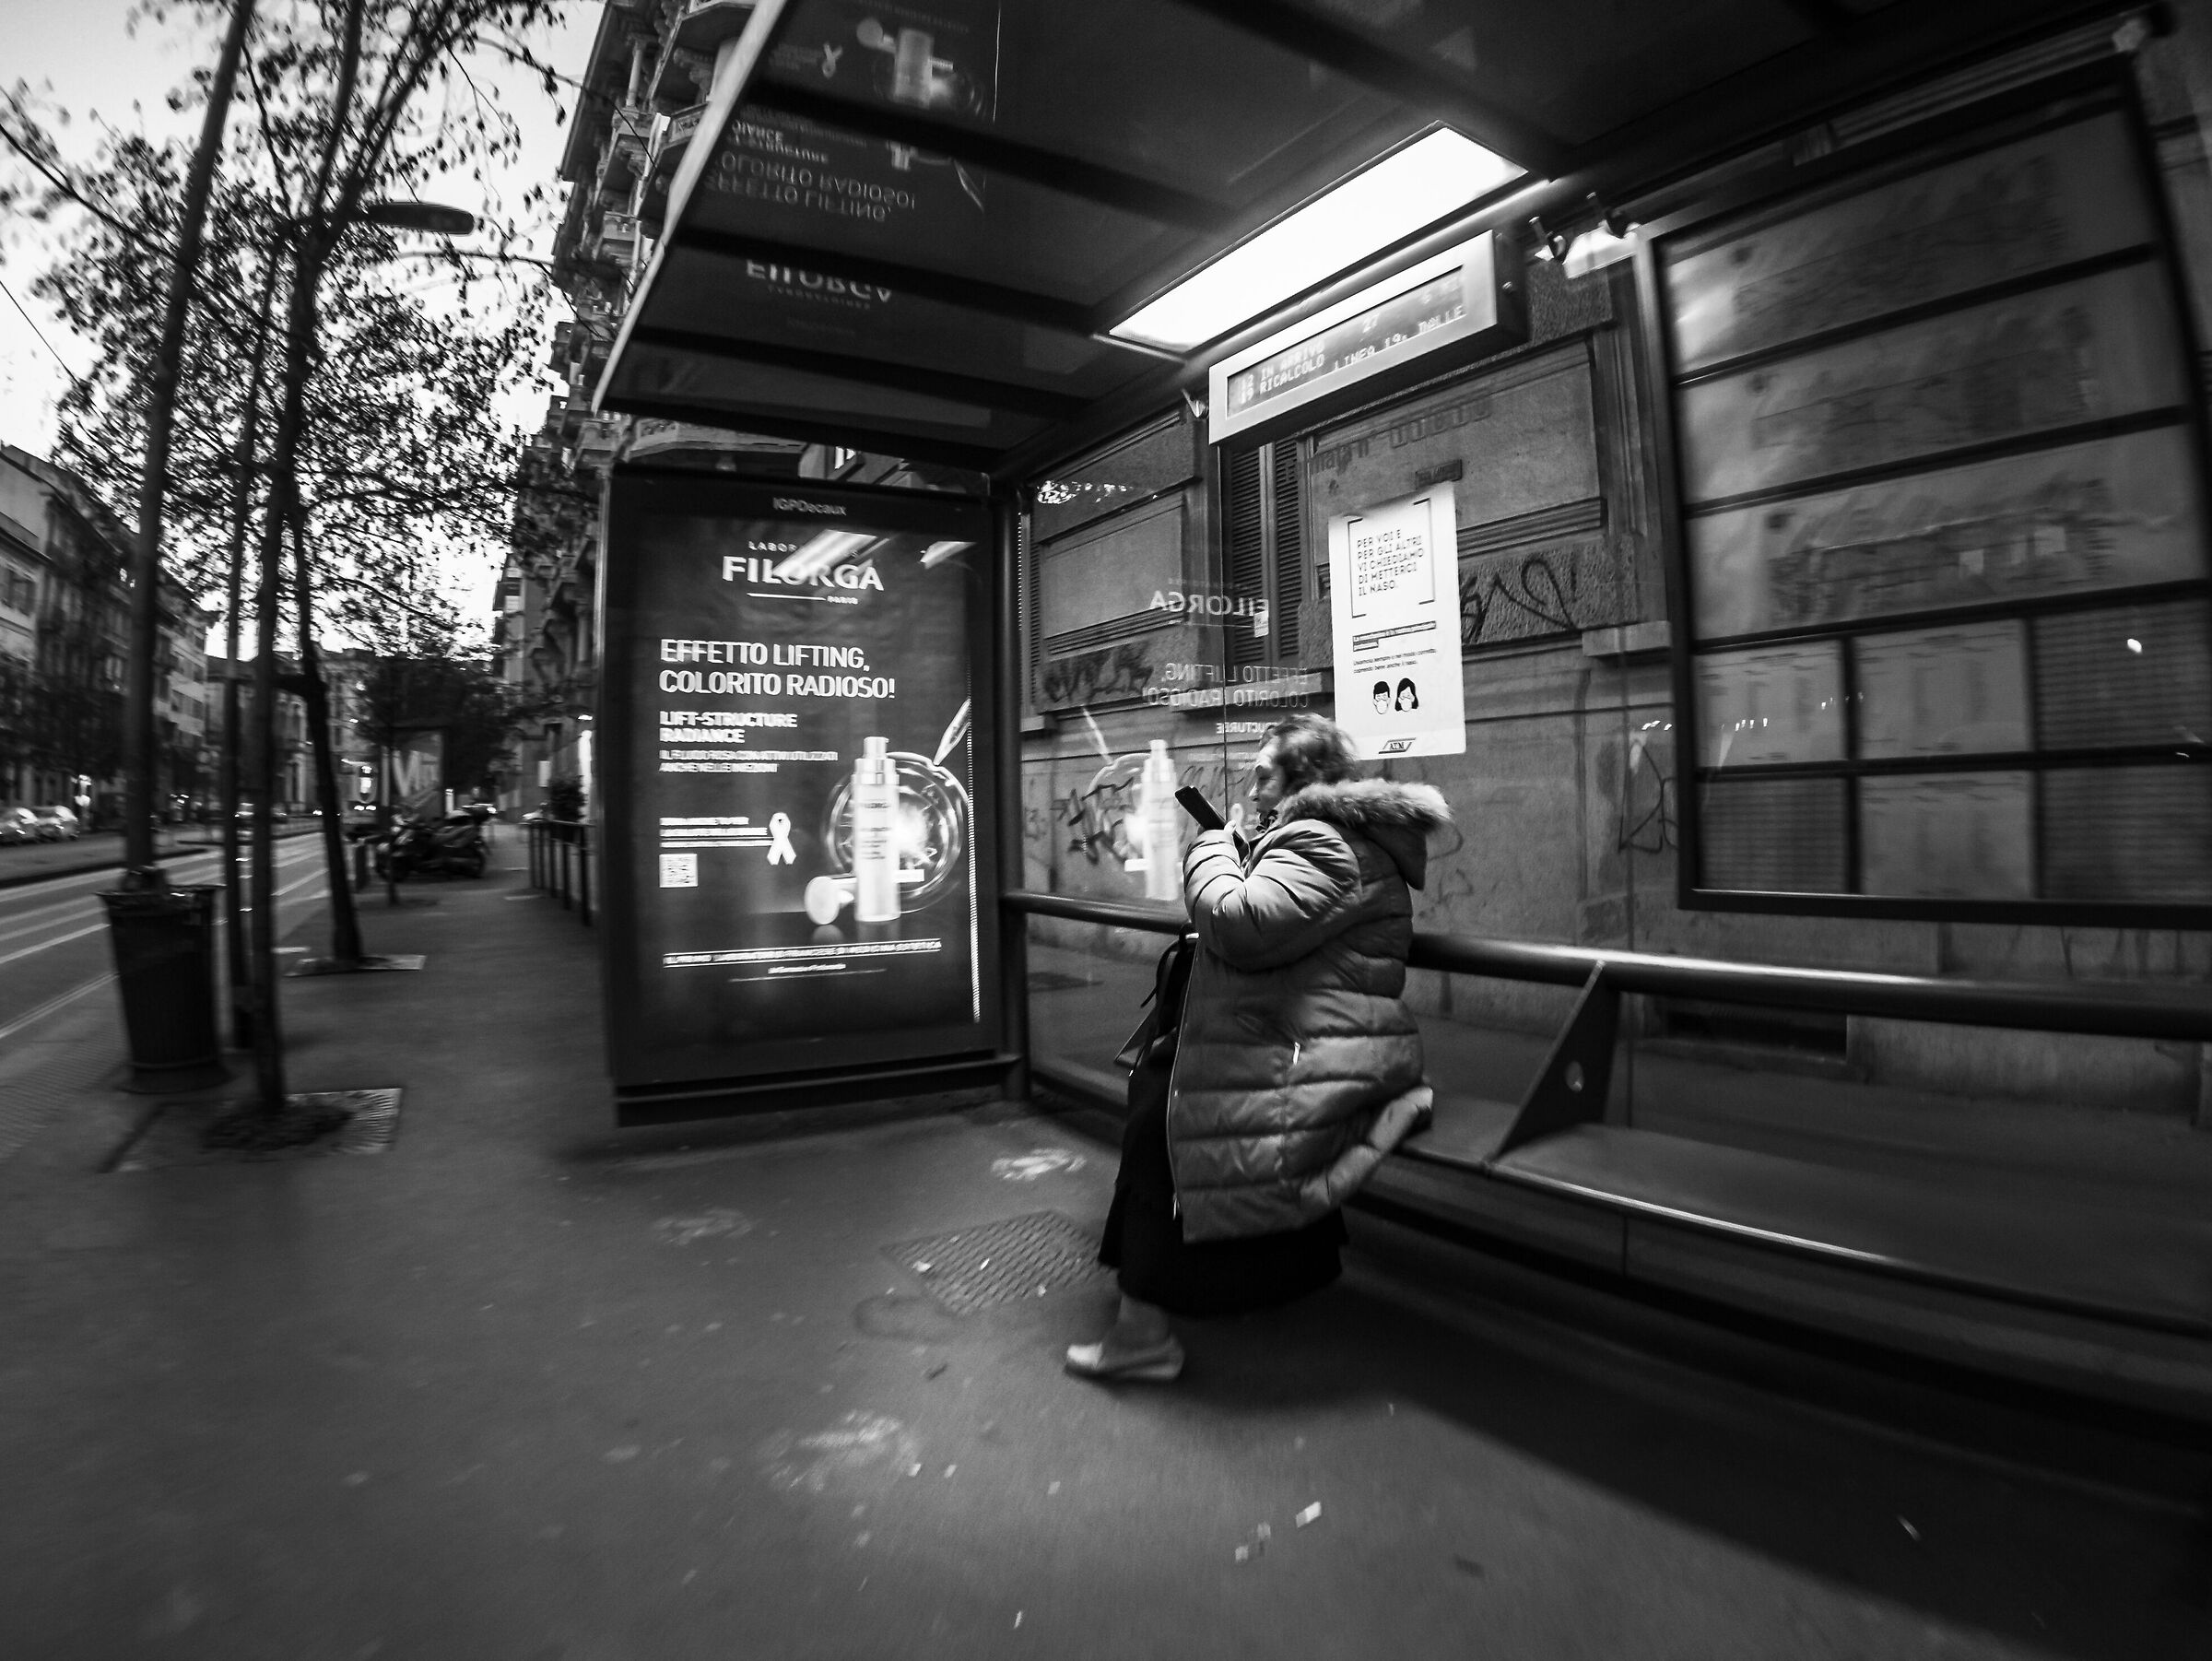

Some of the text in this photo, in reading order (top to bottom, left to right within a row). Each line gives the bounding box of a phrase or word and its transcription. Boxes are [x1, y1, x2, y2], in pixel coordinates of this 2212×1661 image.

[722, 555, 885, 592] FILORGA
[661, 639, 768, 666] EFFETTO
[659, 669, 896, 699] COLORITO RADIOSO!
